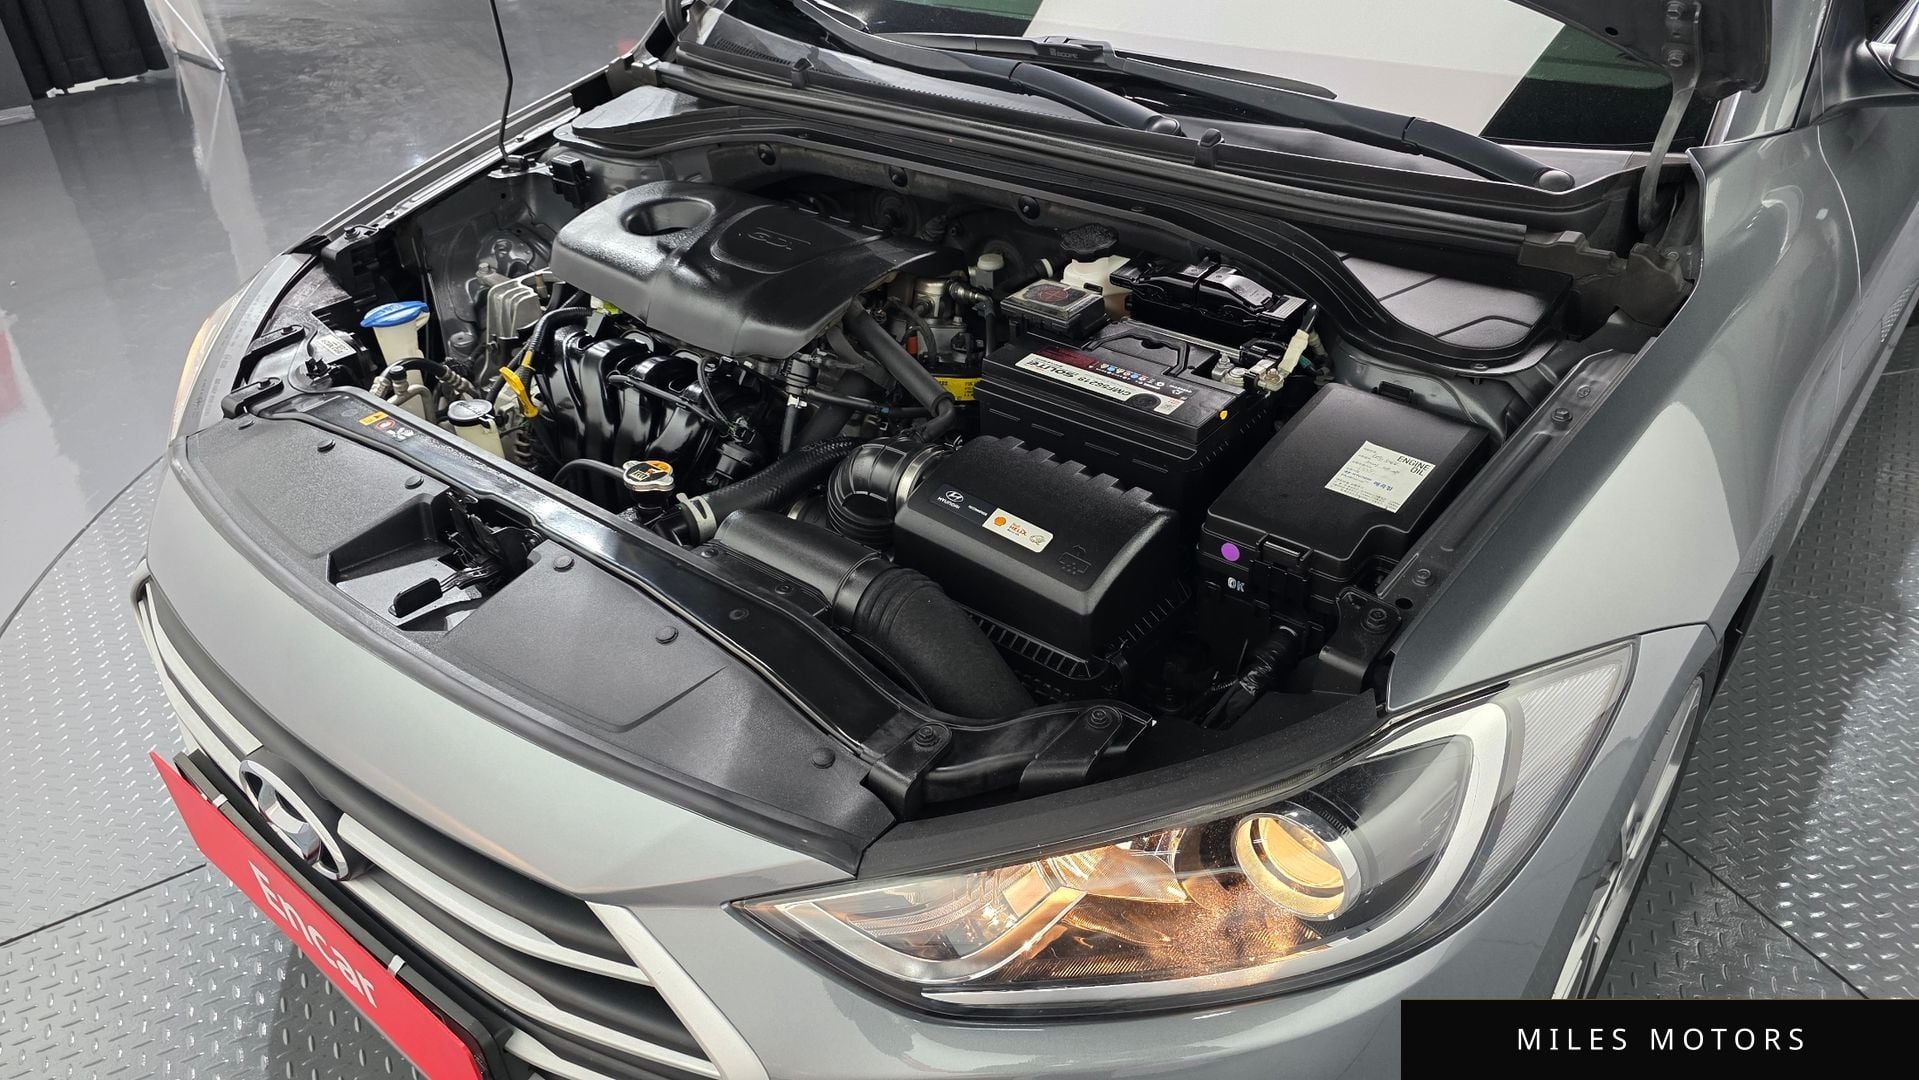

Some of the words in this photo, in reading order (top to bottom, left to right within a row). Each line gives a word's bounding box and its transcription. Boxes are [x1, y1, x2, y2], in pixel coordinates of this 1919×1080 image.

[1397, 455, 1431, 471] ENGINE
[1410, 466, 1425, 477] OIL
[1227, 577, 1246, 593] OK
[248, 860, 378, 1008] Encar
